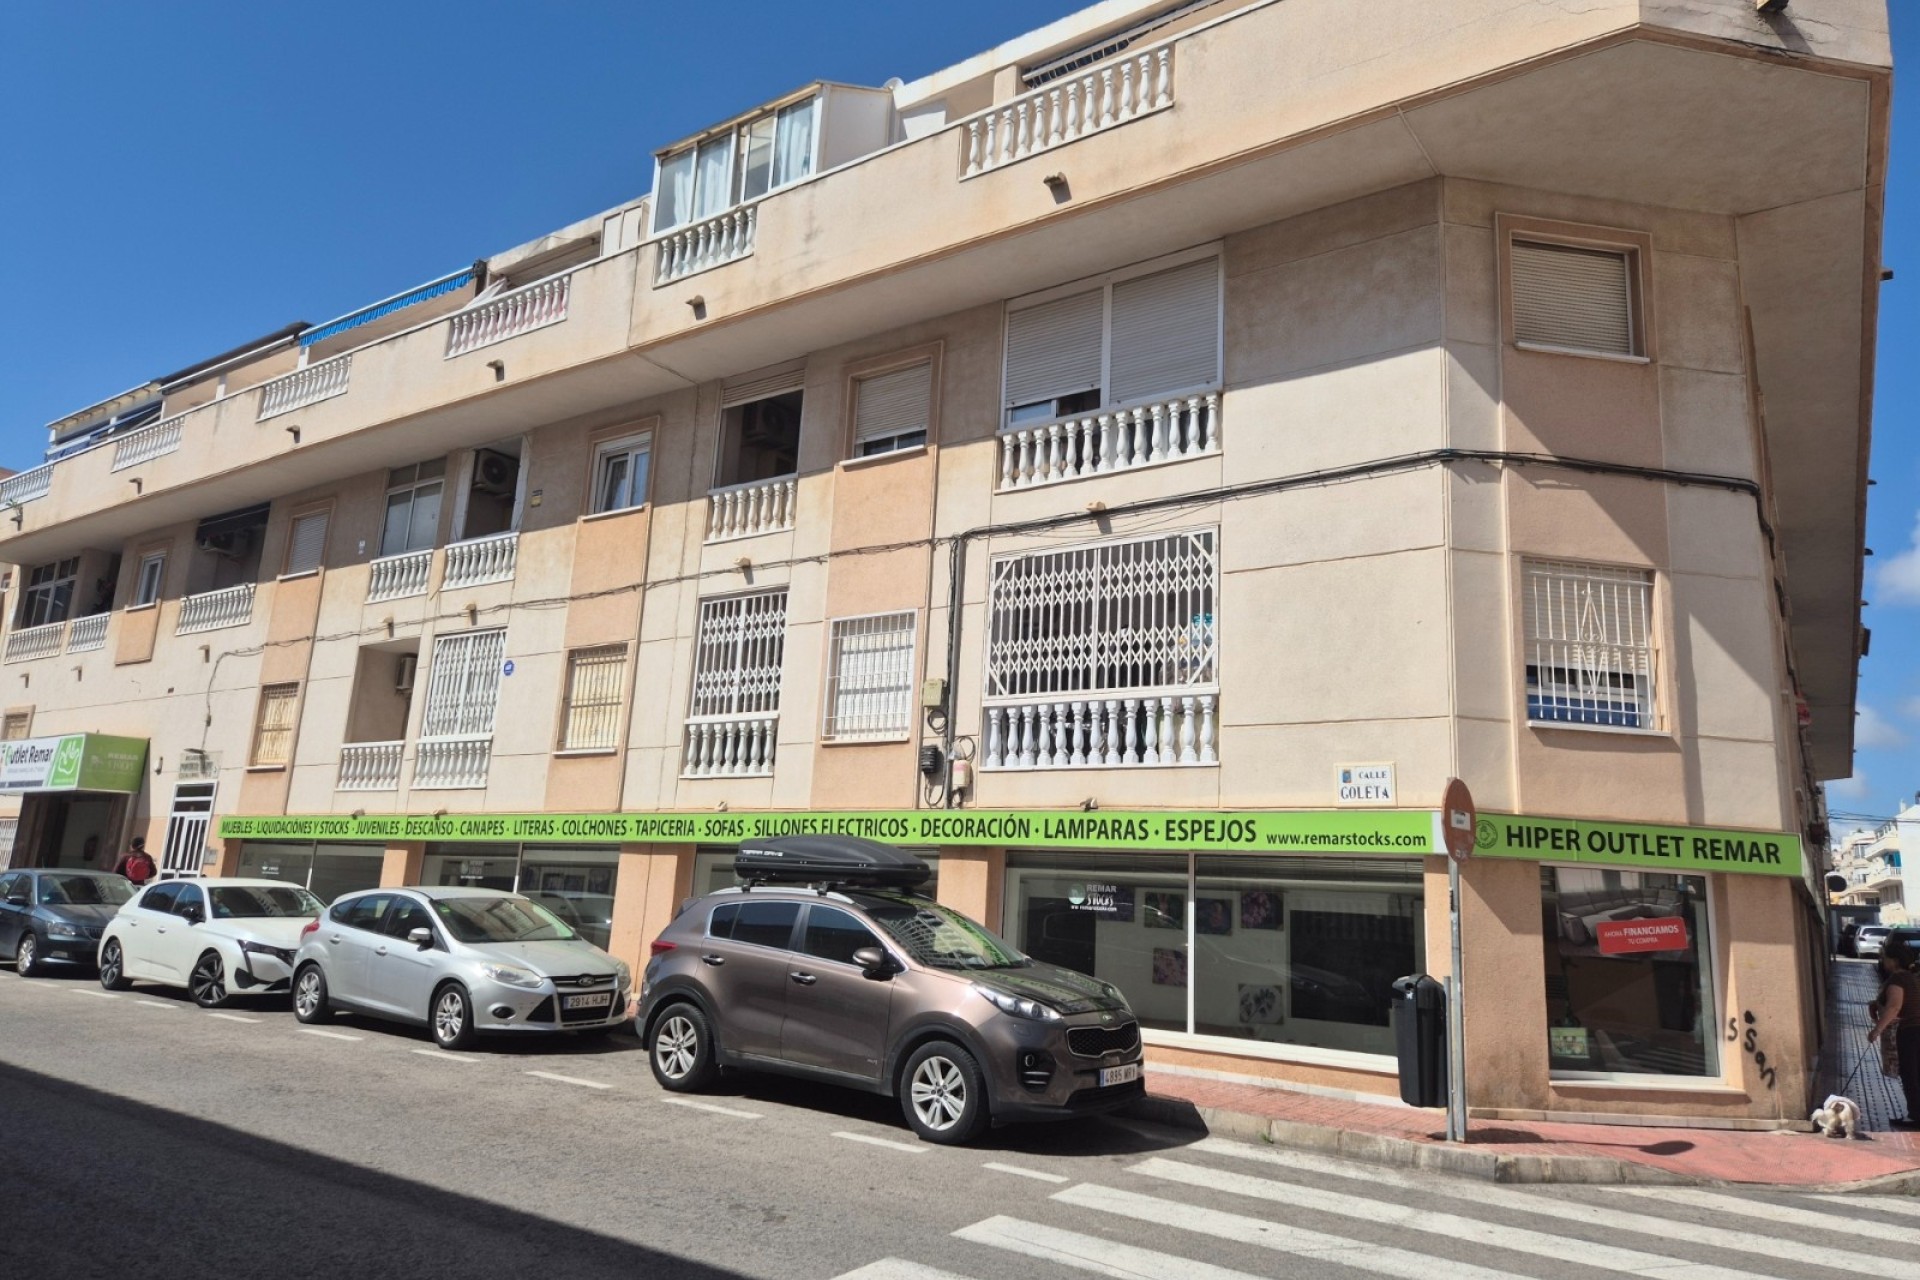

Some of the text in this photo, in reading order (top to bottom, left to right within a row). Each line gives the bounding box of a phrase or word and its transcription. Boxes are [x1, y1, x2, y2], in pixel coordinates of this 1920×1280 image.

[28, 746, 54, 763] Remar
[1358, 771, 1387, 779] CALLE
[1340, 785, 1389, 800] GOLETA
[221, 820, 252, 834] MUEBLES
[313, 821, 320, 834] Y
[319, 820, 350, 834] STOCKS
[354, 820, 400, 835] JUVENILES
[405, 819, 454, 836] DESCANSO
[460, 820, 504, 836] CANAPES
[513, 819, 554, 836] LITERAS
[561, 819, 627, 836] COLCHONES
[635, 819, 695, 836] TAPICERIA
[704, 819, 744, 837] SOFAS
[754, 818, 817, 837] SILLONES
[821, 818, 908, 837] ELECTRICOS
[920, 815, 1030, 838] DECORACIÓN
[1044, 818, 1149, 841] LAMPARAS
[1165, 818, 1257, 843] ESPEJOS
[1266, 831, 1427, 846] www.remarstocks.com
[1506, 825, 1581, 851] HIPER
[1586, 830, 1684, 858] OUTLET
[1692, 837, 1780, 864] REMAR
[1086, 884, 1117, 893] REMAR
[1623, 925, 1680, 937] FINANCIAMOS
